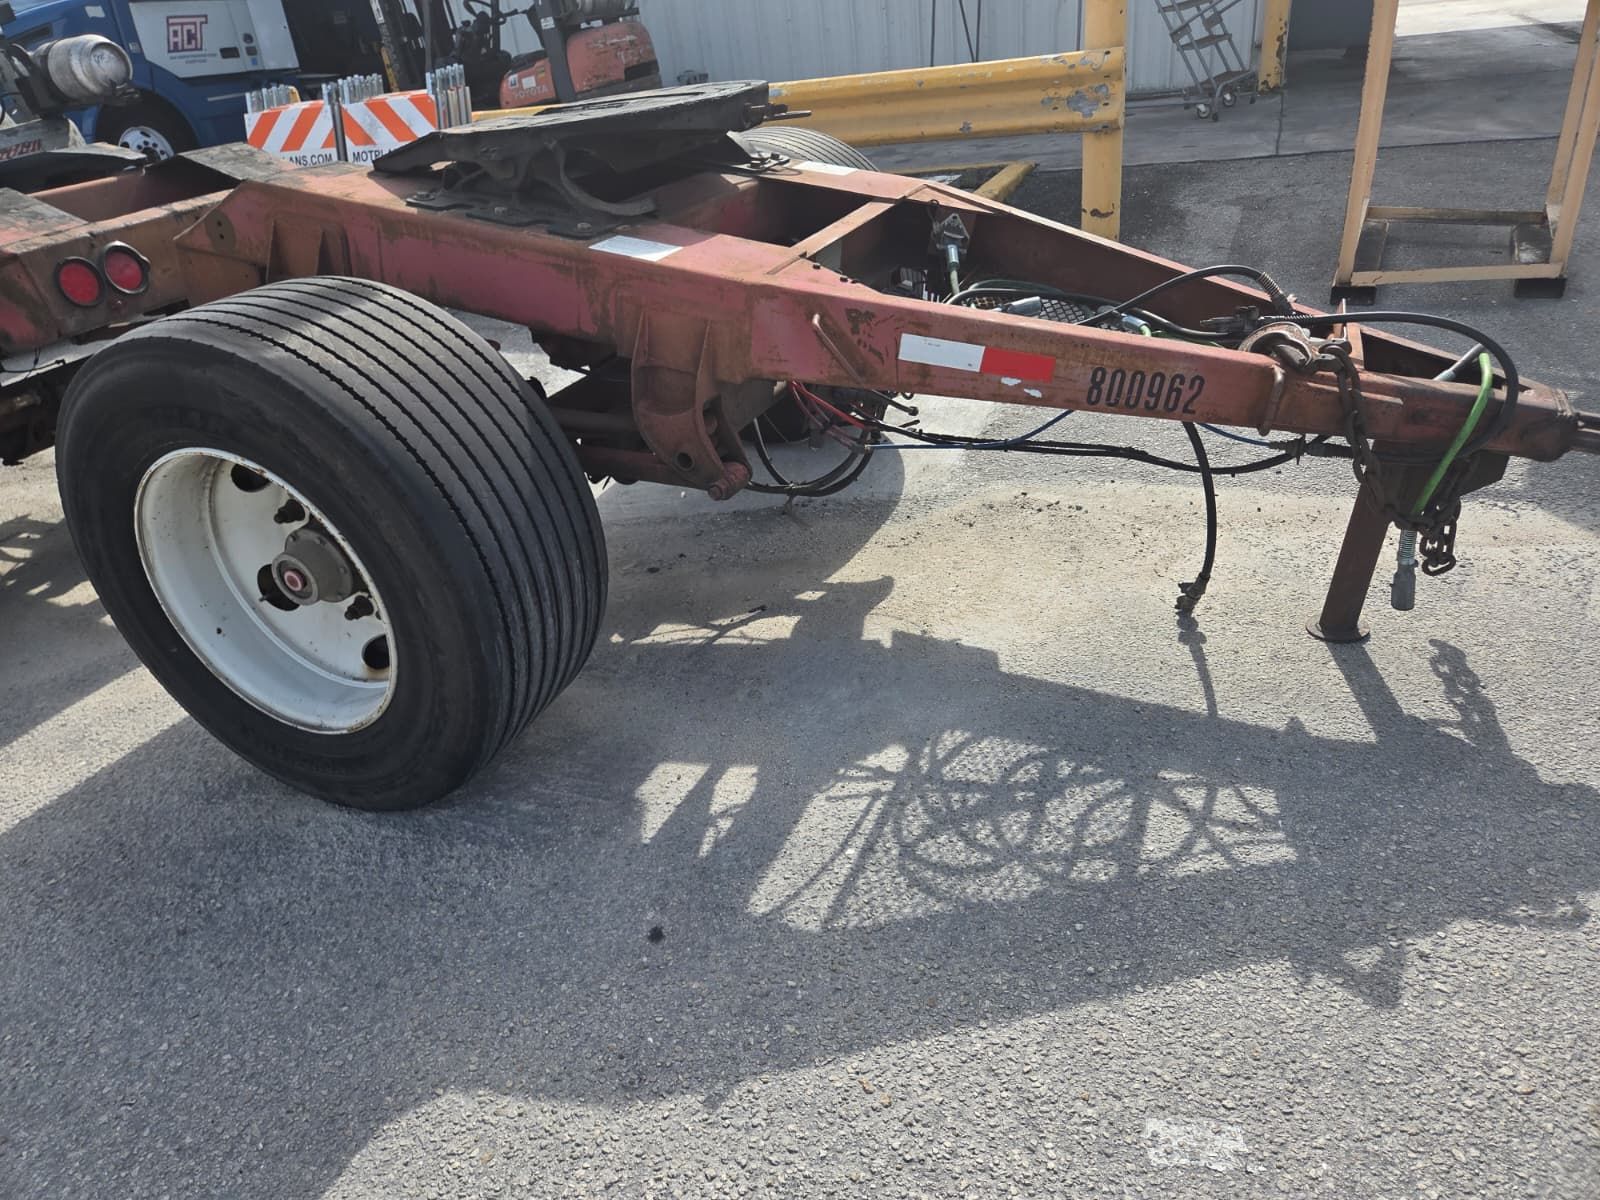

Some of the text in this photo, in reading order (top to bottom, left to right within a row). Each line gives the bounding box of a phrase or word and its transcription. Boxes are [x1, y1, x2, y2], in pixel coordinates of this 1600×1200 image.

[167, 14, 208, 53] ACT
[514, 85, 549, 100] TOYOTA
[1086, 366, 1205, 415] 800962
